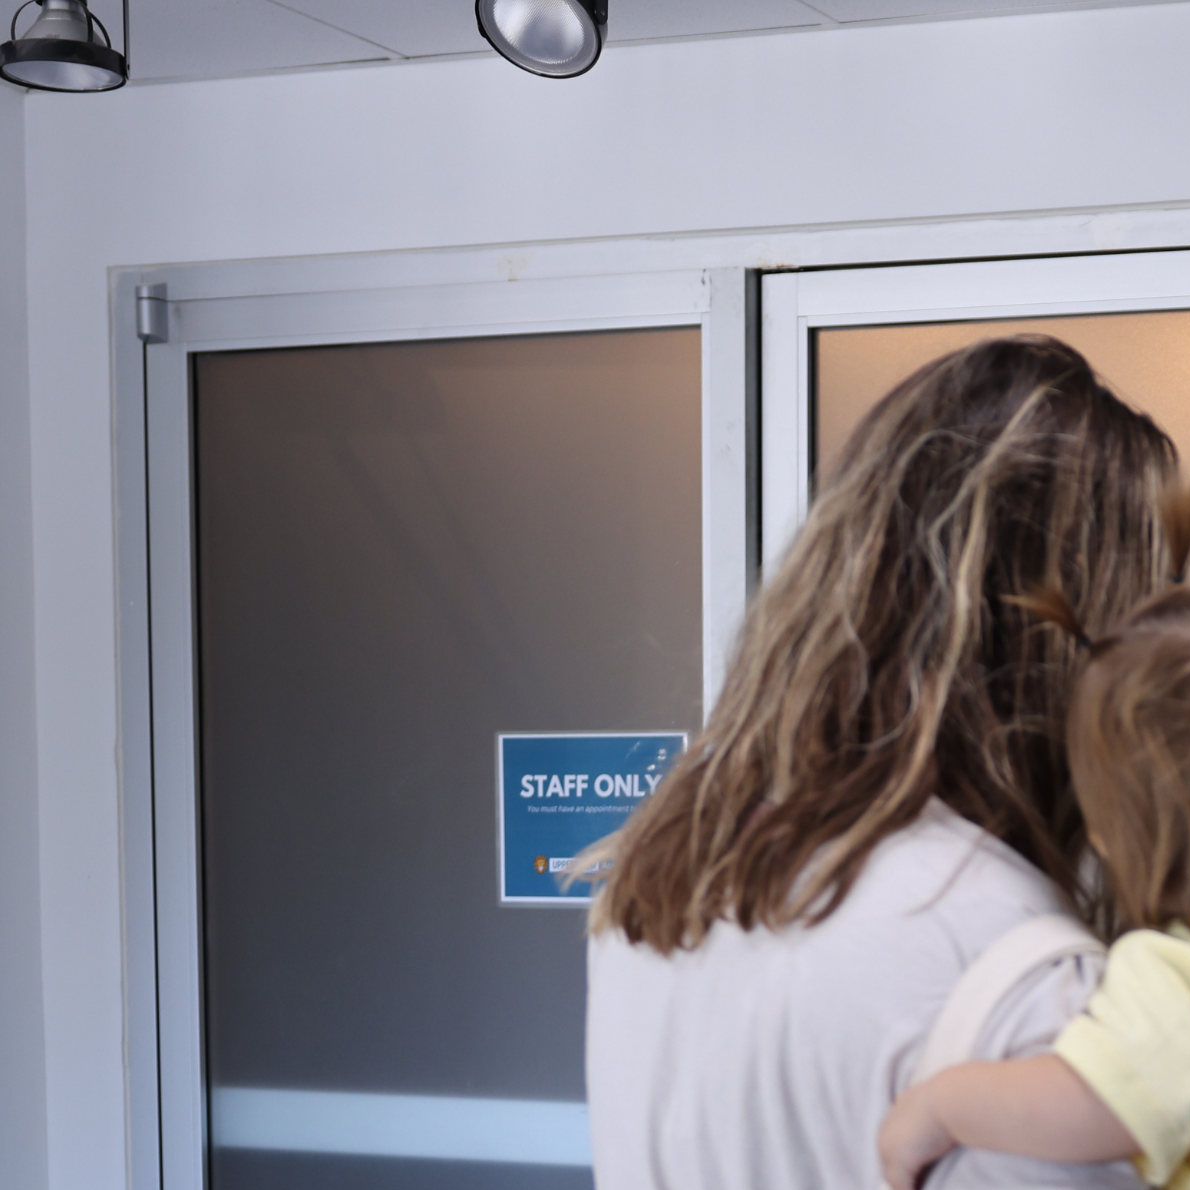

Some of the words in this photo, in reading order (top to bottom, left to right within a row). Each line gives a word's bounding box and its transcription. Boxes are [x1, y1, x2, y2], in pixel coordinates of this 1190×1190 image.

[520, 774, 589, 798] STAFF
[593, 773, 663, 798] ONLY
[527, 804, 540, 813] You
[540, 805, 557, 813] must
[557, 804, 574, 813] have
[584, 804, 629, 815] appointment
